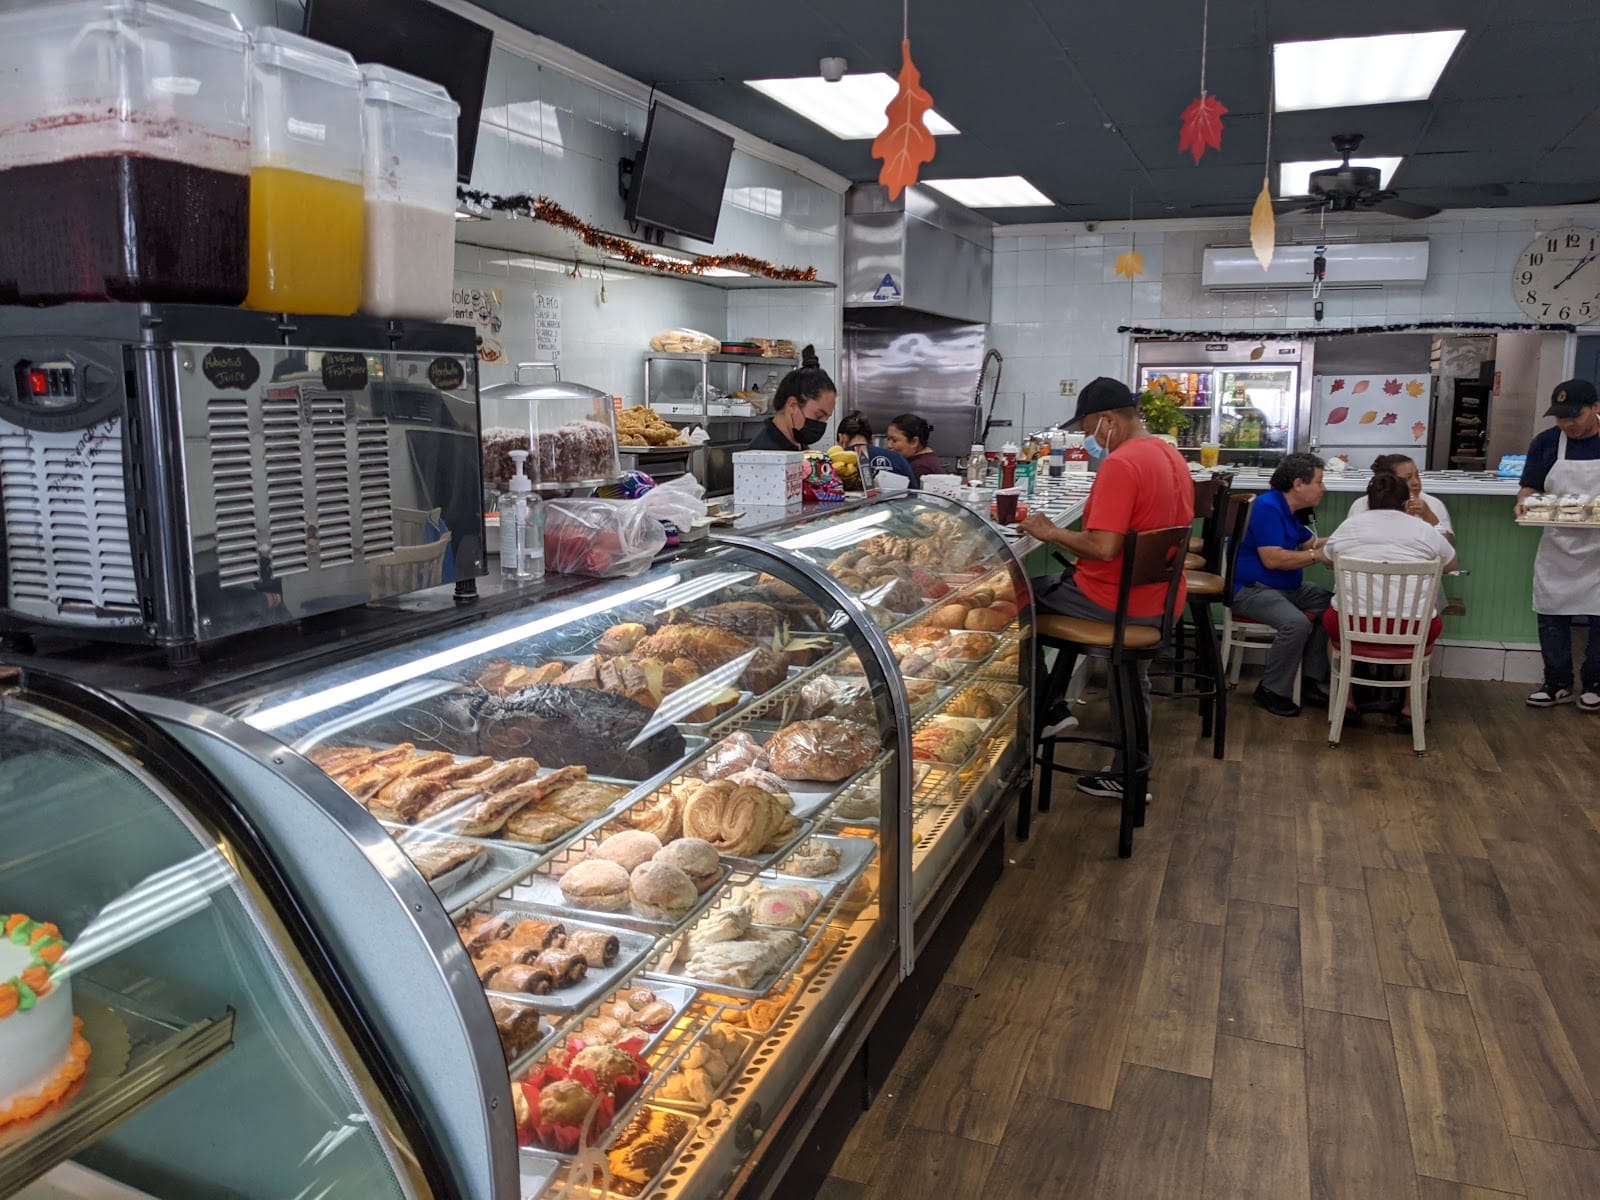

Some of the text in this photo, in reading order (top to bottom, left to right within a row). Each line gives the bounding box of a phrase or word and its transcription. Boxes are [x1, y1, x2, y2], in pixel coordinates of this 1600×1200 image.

[1547, 239, 1557, 252] 11
[1565, 234, 1580, 248] 12
[1590, 238, 1595, 251] 1
[1529, 253, 1543, 266] 10
[1521, 271, 1533, 285] 9
[1526, 290, 1537, 304] 8
[1541, 303, 1551, 316] 7
[1559, 306, 1571, 320] 6
[1579, 302, 1590, 316] 5
